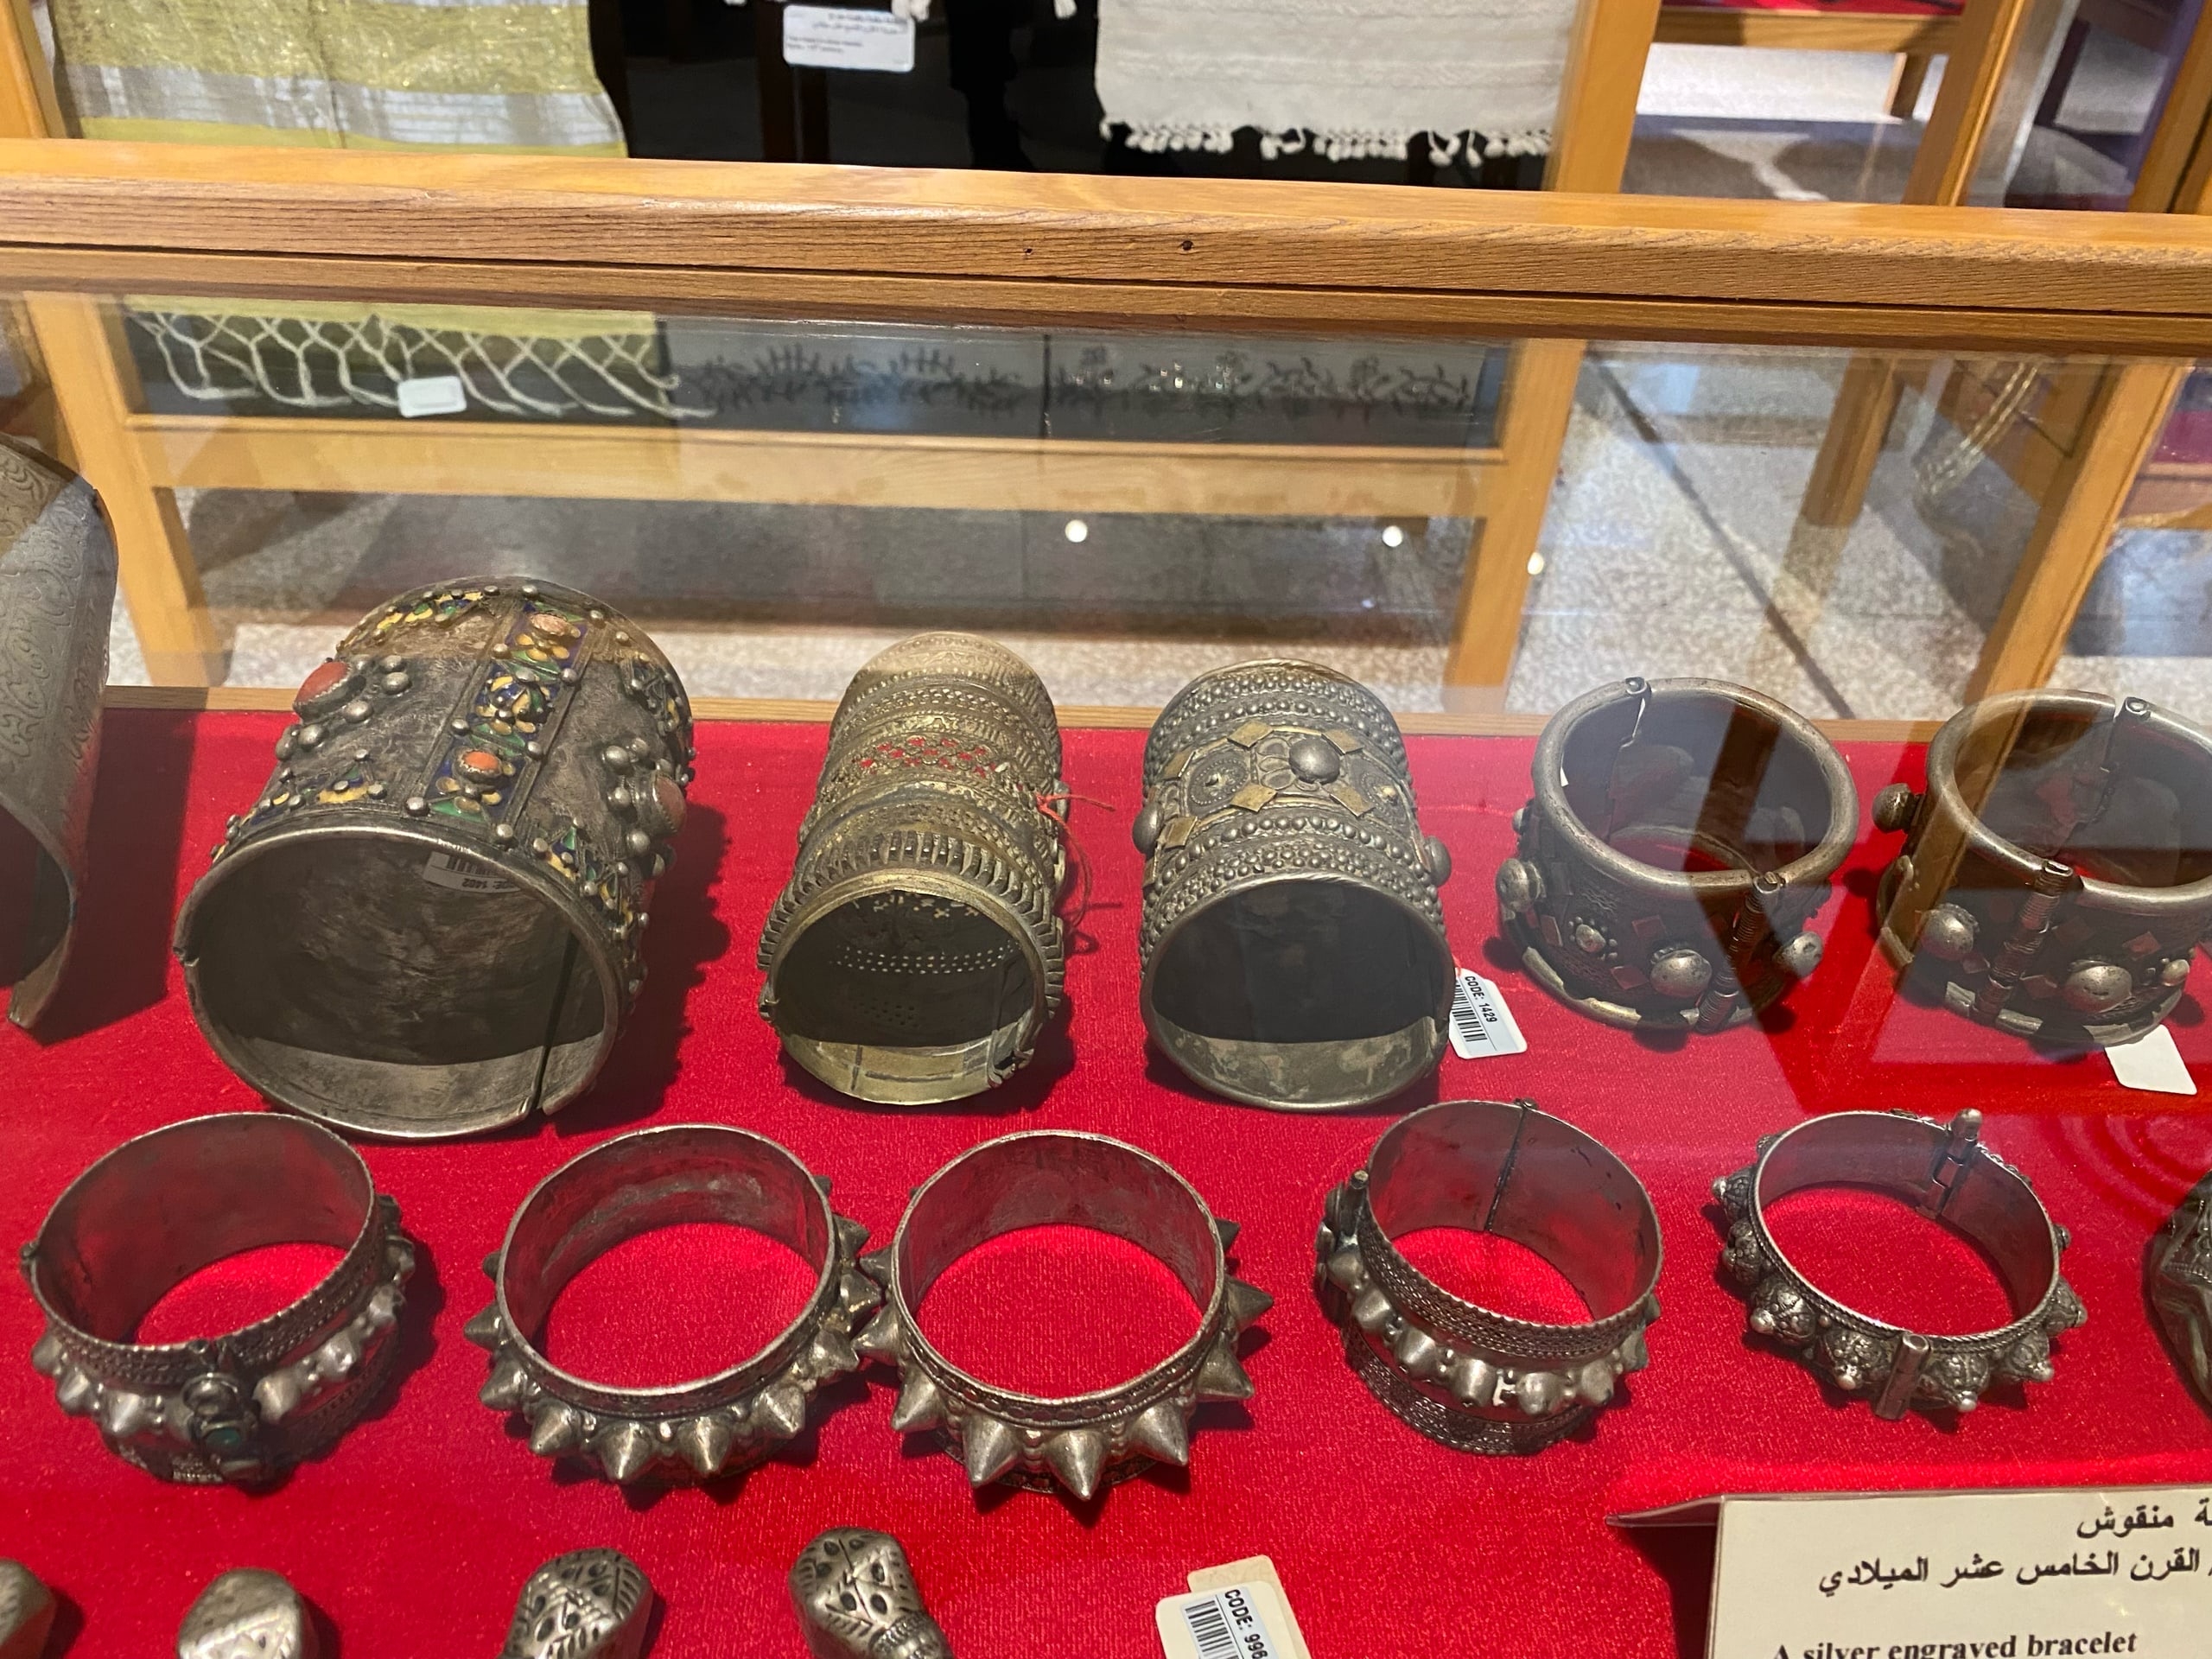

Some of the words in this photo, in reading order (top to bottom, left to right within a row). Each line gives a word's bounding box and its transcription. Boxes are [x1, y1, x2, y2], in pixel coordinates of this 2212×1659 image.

[1465, 976, 1484, 1000] CODE:
[1479, 1003, 1497, 1022] 1429
[2076, 1505, 2174, 1539] منقوش
[1819, 1555, 1929, 1598] الميلادي
[1940, 1553, 2005, 1588] عشر
[2016, 1549, 2119, 1585] الخامس
[2130, 1547, 2201, 1581] القرن
[1224, 1589, 1252, 1630] CODE:
[1803, 1643, 1880, 1659] silver
[1888, 1635, 2017, 1659] engraved
[2028, 1631, 2137, 1657] bracelet
